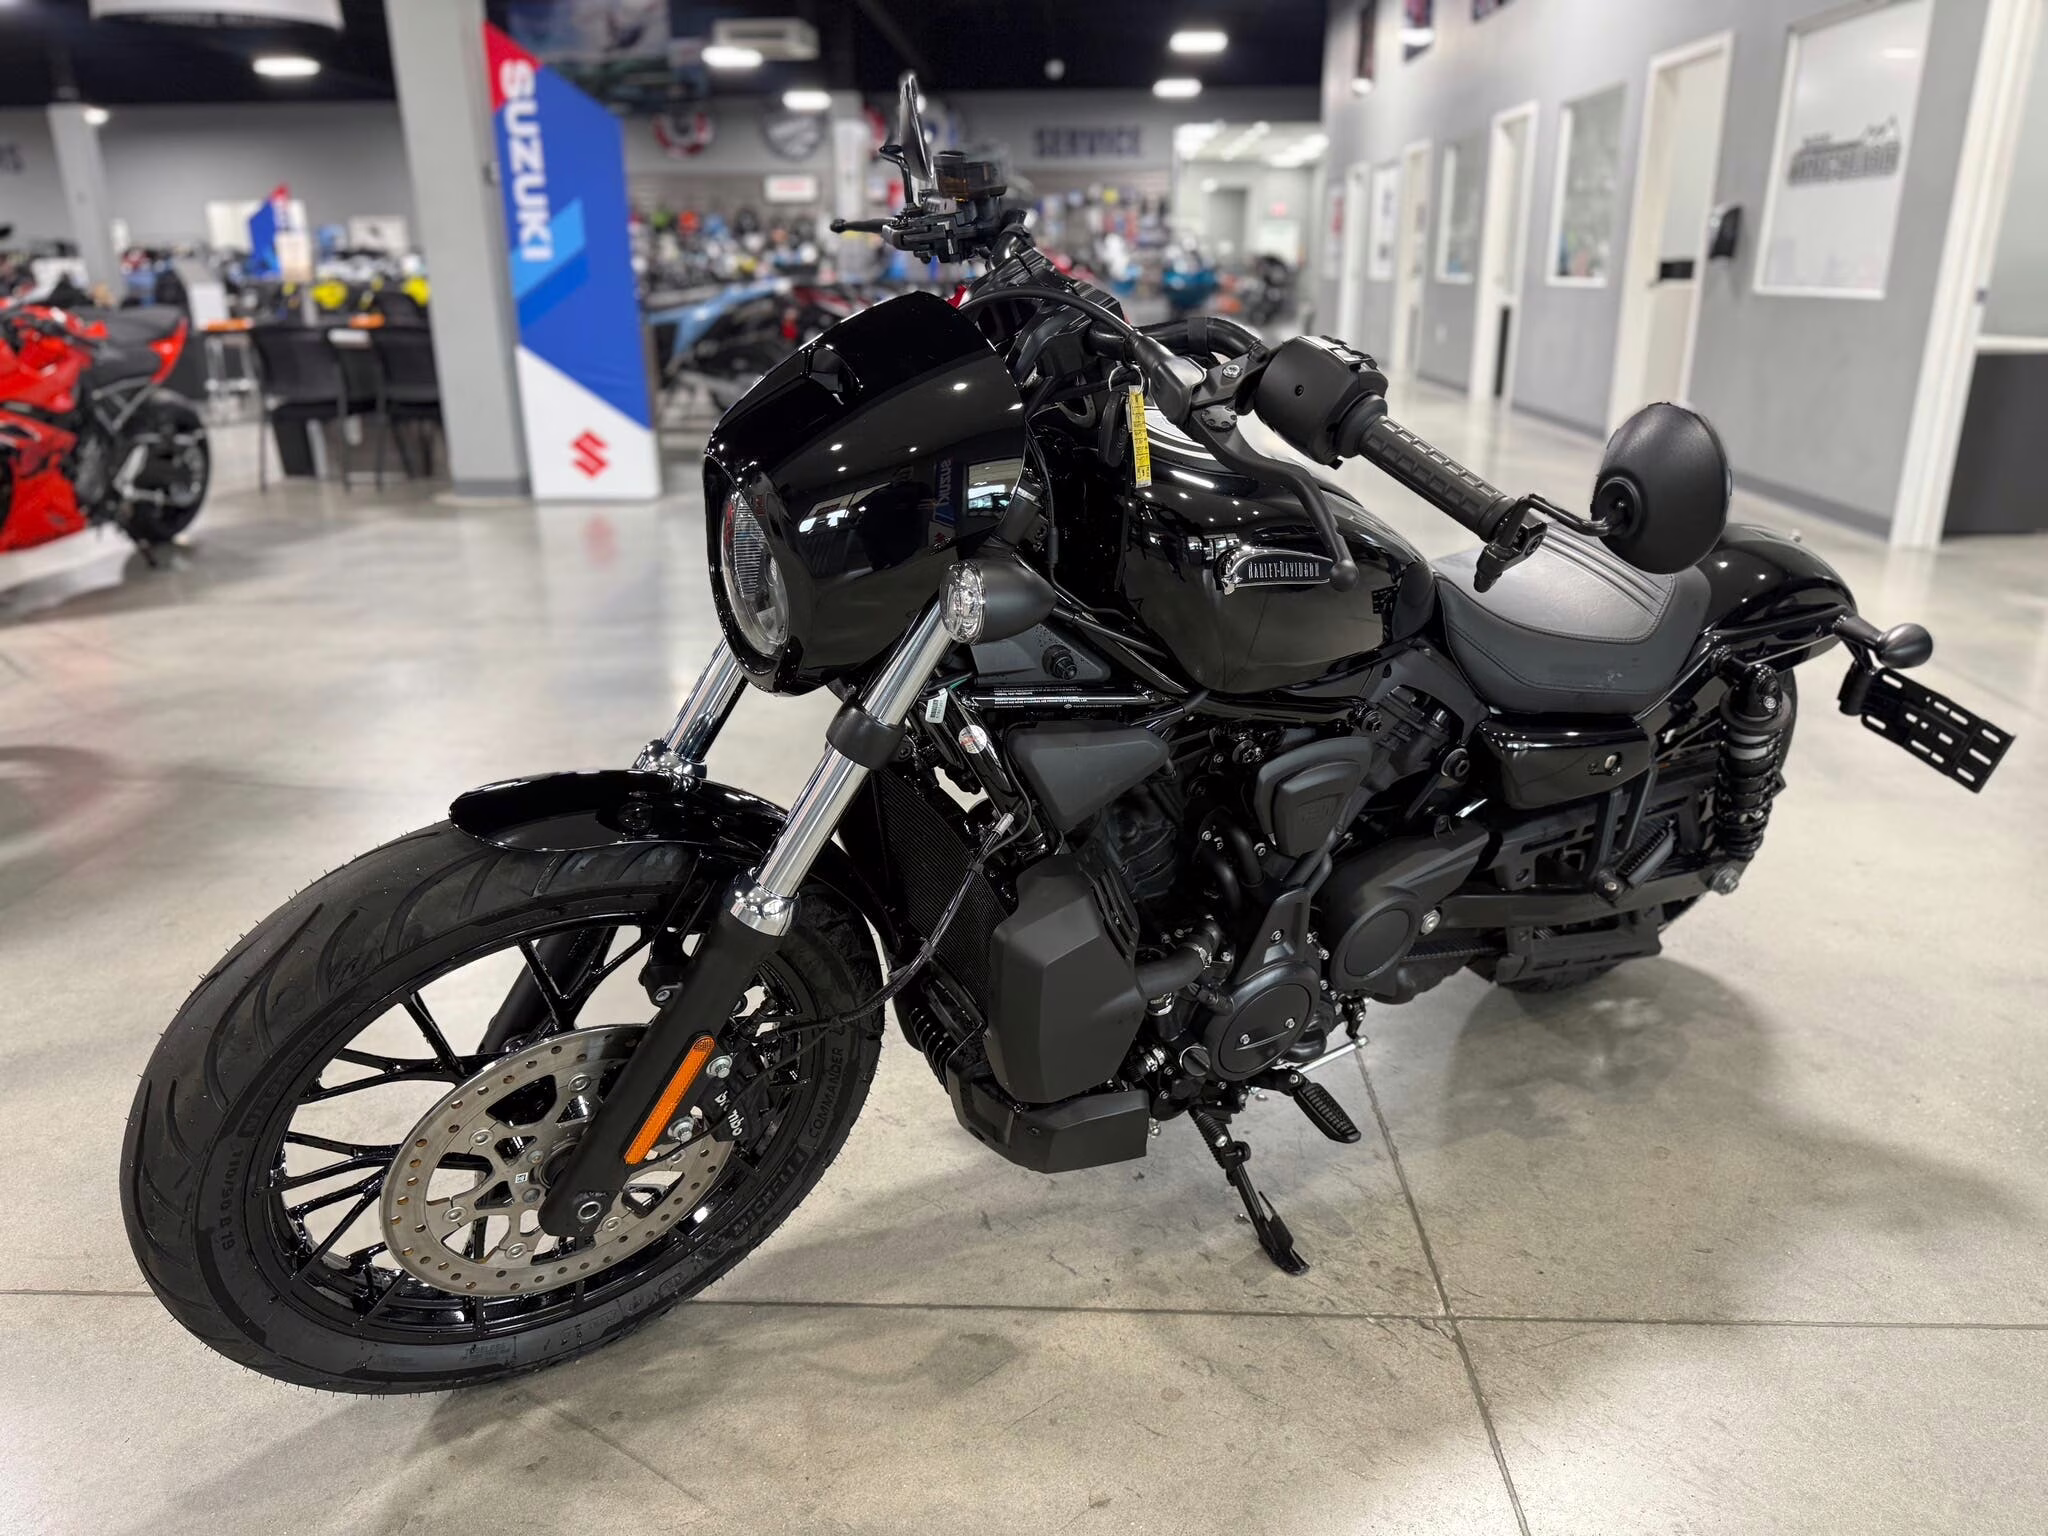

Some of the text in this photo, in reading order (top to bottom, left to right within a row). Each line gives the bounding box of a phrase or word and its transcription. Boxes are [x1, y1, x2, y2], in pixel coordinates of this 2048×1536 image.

[500, 59, 554, 262] SUZUKI
[1248, 561, 1320, 579] HARLEY-DAVIDSON
[808, 1047, 845, 1138] COMMANDER
